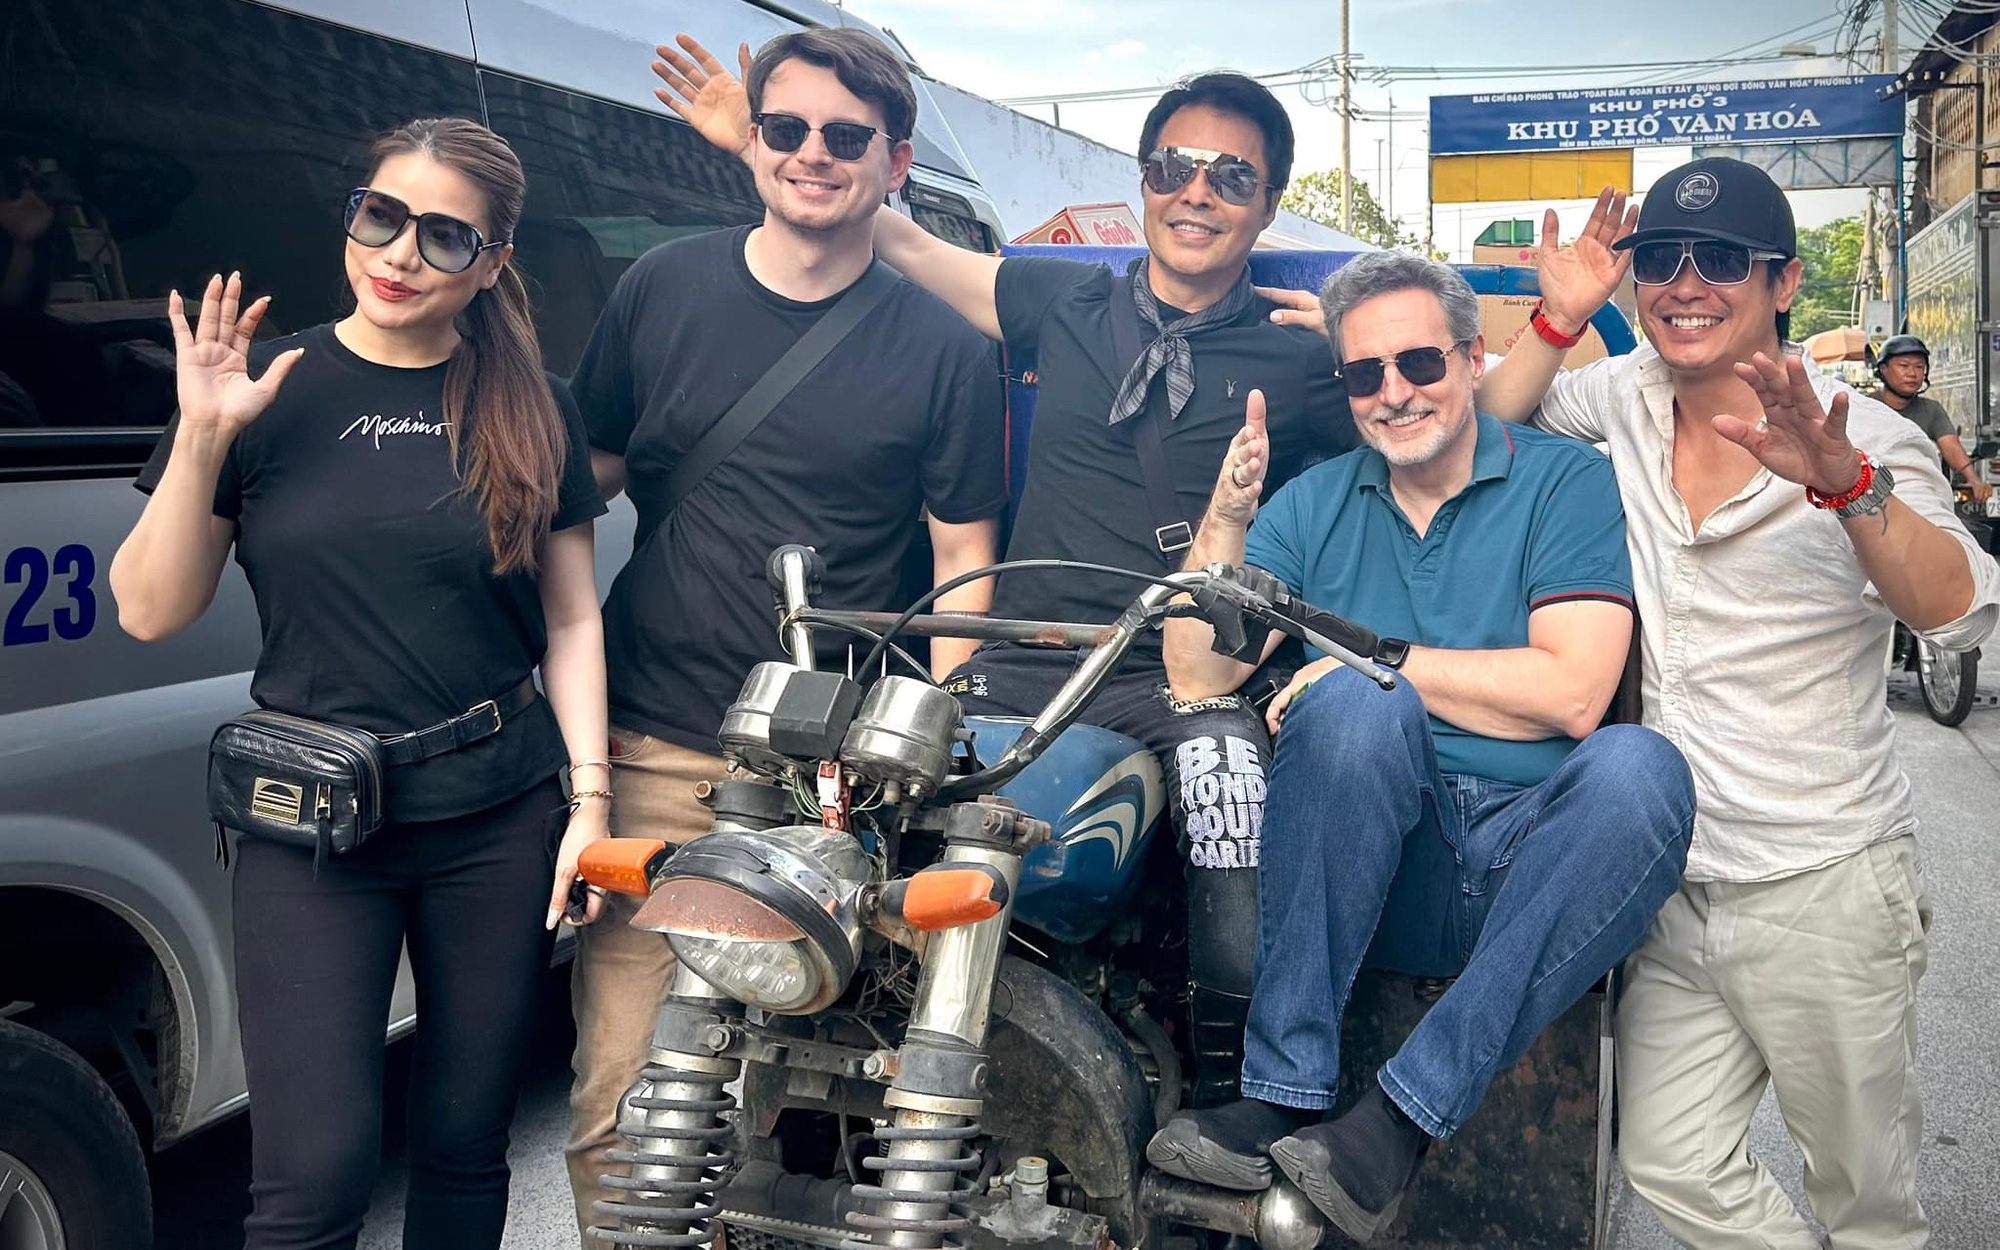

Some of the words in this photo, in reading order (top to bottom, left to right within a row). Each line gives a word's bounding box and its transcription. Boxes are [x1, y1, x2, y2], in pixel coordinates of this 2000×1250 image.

[1472, 95, 1490, 103] BAN
[1525, 92, 1554, 101] PHONG
[1854, 77, 1864, 85] 14
[1589, 100, 1643, 114] KHU
[1652, 92, 1713, 110] PHỐ
[1712, 96, 1728, 107] 3
[1507, 120, 1580, 141] KHU
[1589, 110, 1663, 138] PHỐ
[1667, 113, 1739, 135] VĂN
[1743, 103, 1821, 131] HÓA
[338, 410, 454, 451] Moschino
[3, 543, 97, 647] 23
